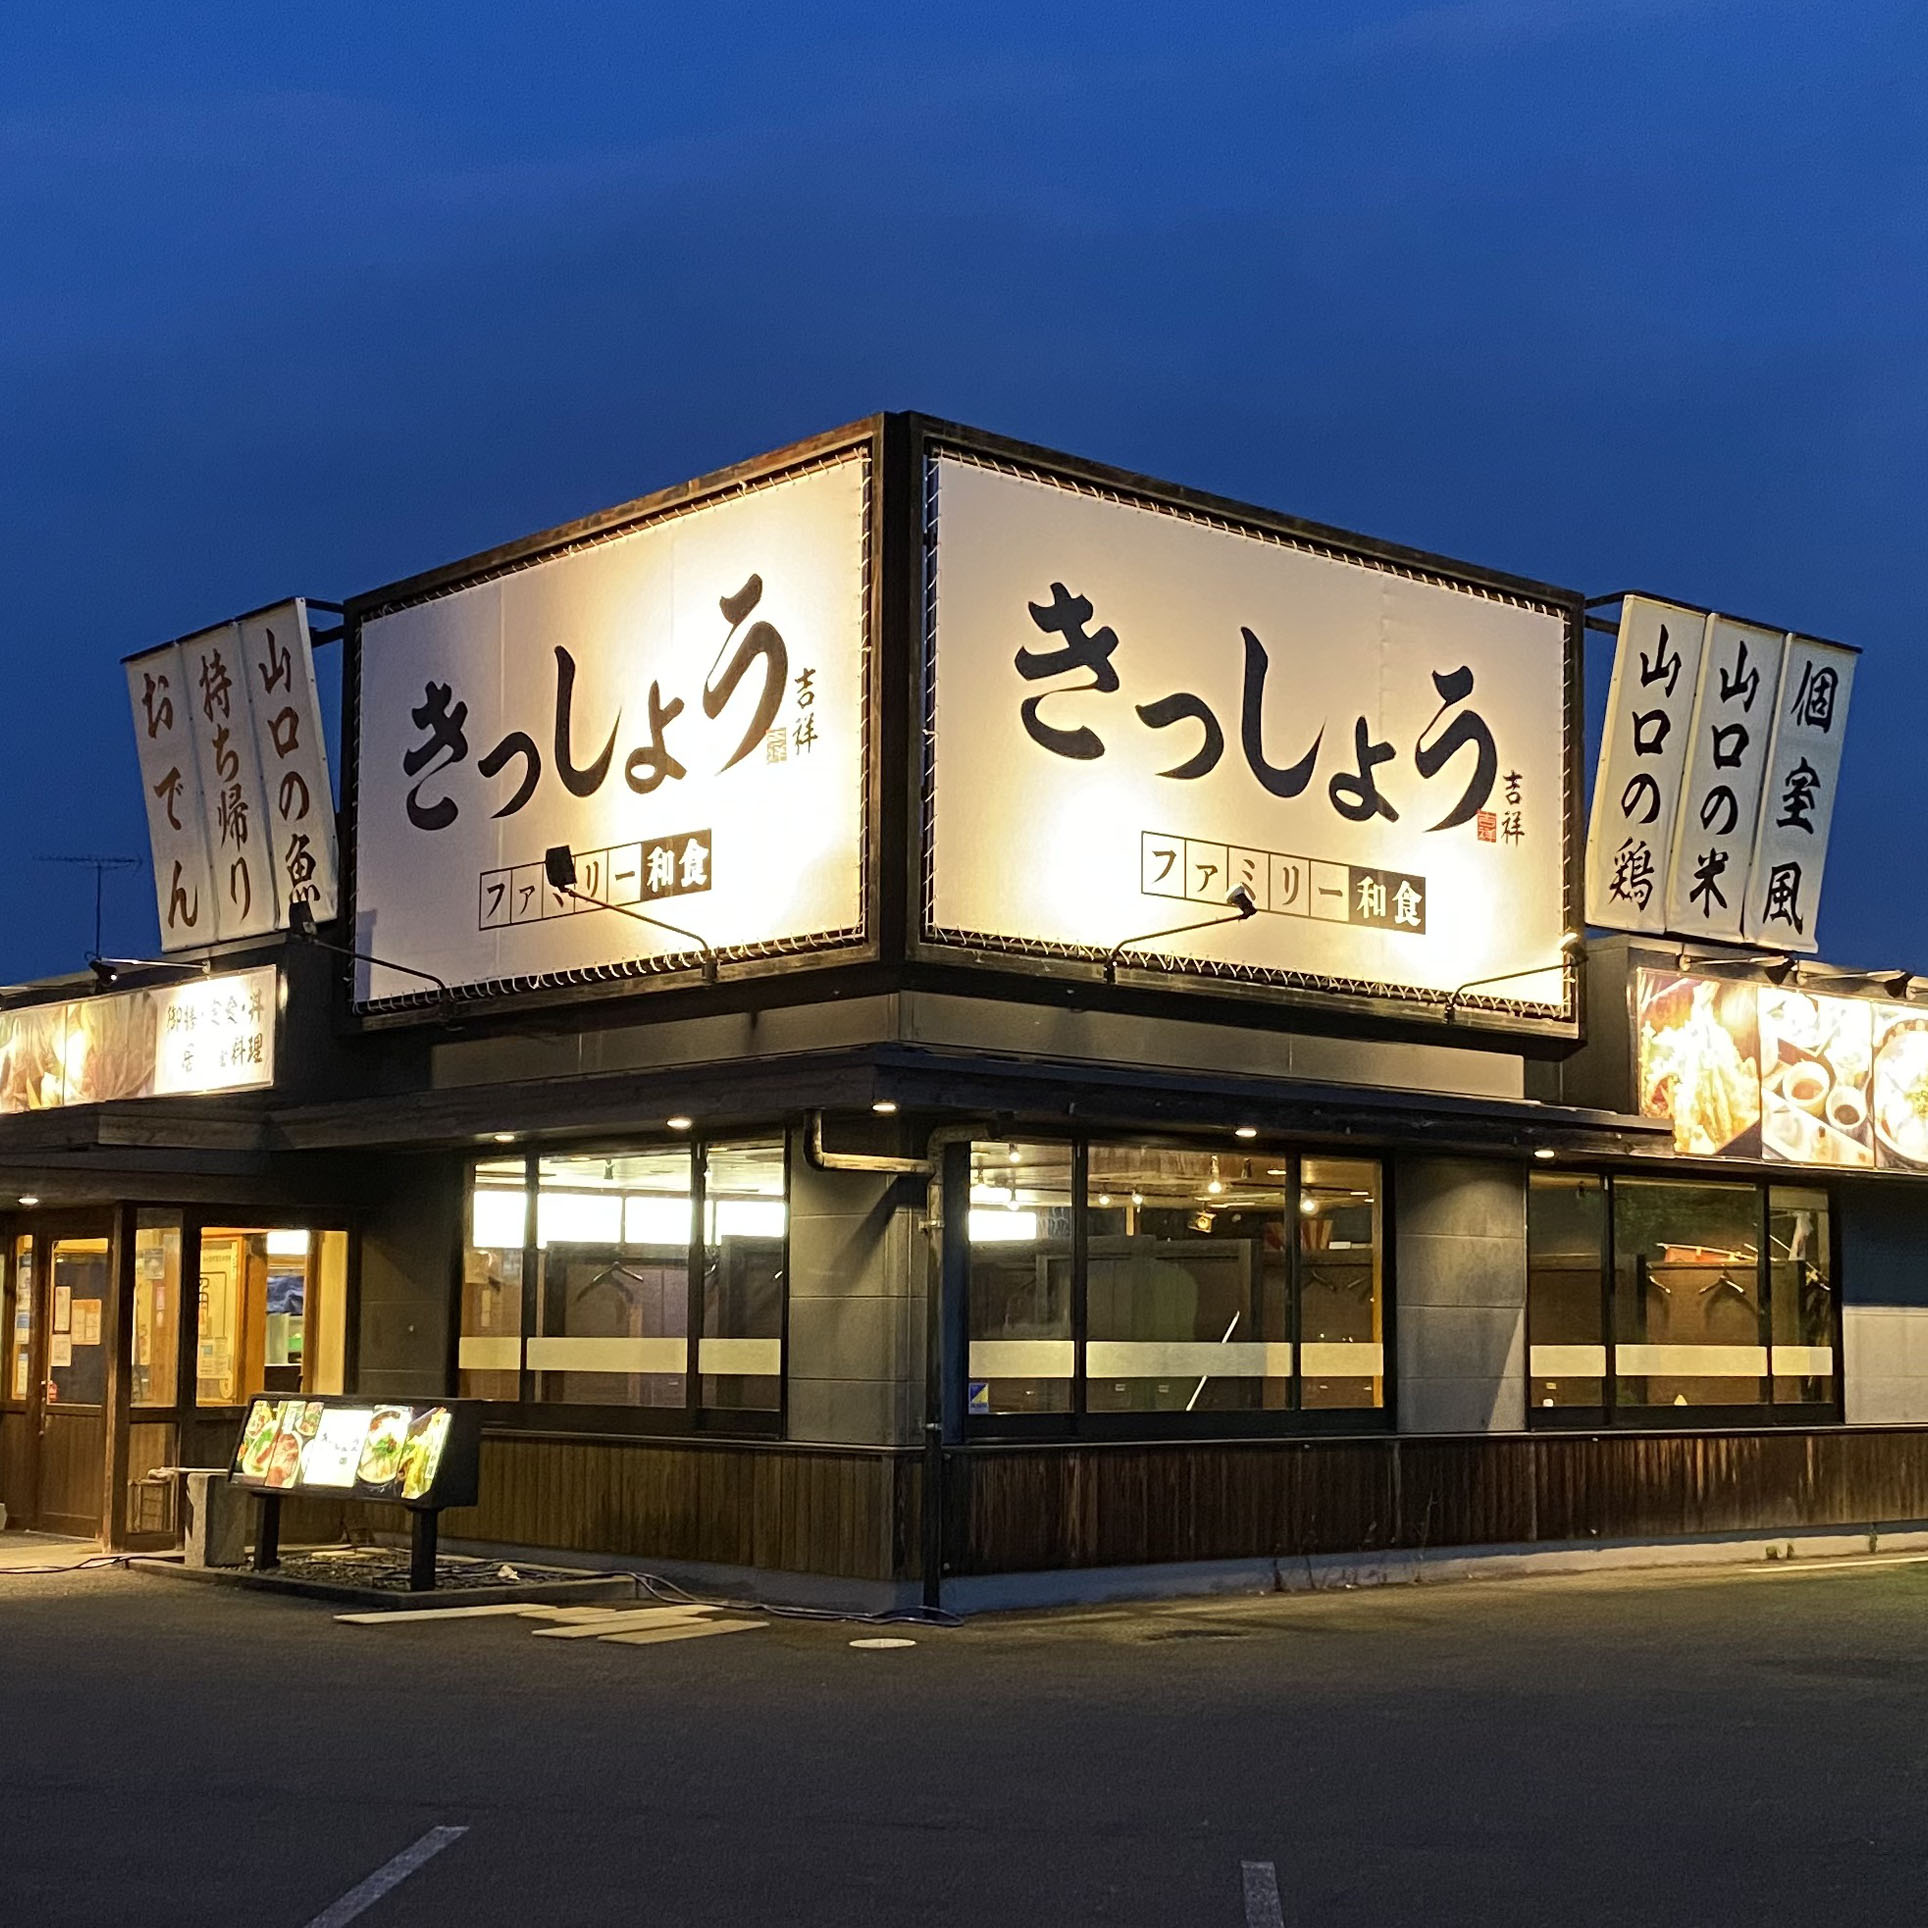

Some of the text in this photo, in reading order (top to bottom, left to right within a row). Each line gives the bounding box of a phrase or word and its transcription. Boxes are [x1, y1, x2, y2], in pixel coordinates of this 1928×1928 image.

[142, 673, 198, 929] おでん
[199, 648, 252, 921] 持ち帰り
[258, 628, 320, 903] 山口の魚
[403, 573, 788, 831] きっしょう
[792, 668, 817, 755] 吉祥
[1014, 582, 1498, 832] きっしょう
[1501, 770, 1525, 847] 吉祥
[1608, 624, 1682, 912] 山口の鶏
[1689, 640, 1760, 918] 山口の米
[1763, 661, 1839, 935] 個室風
[486, 838, 709, 918] ファリー和食
